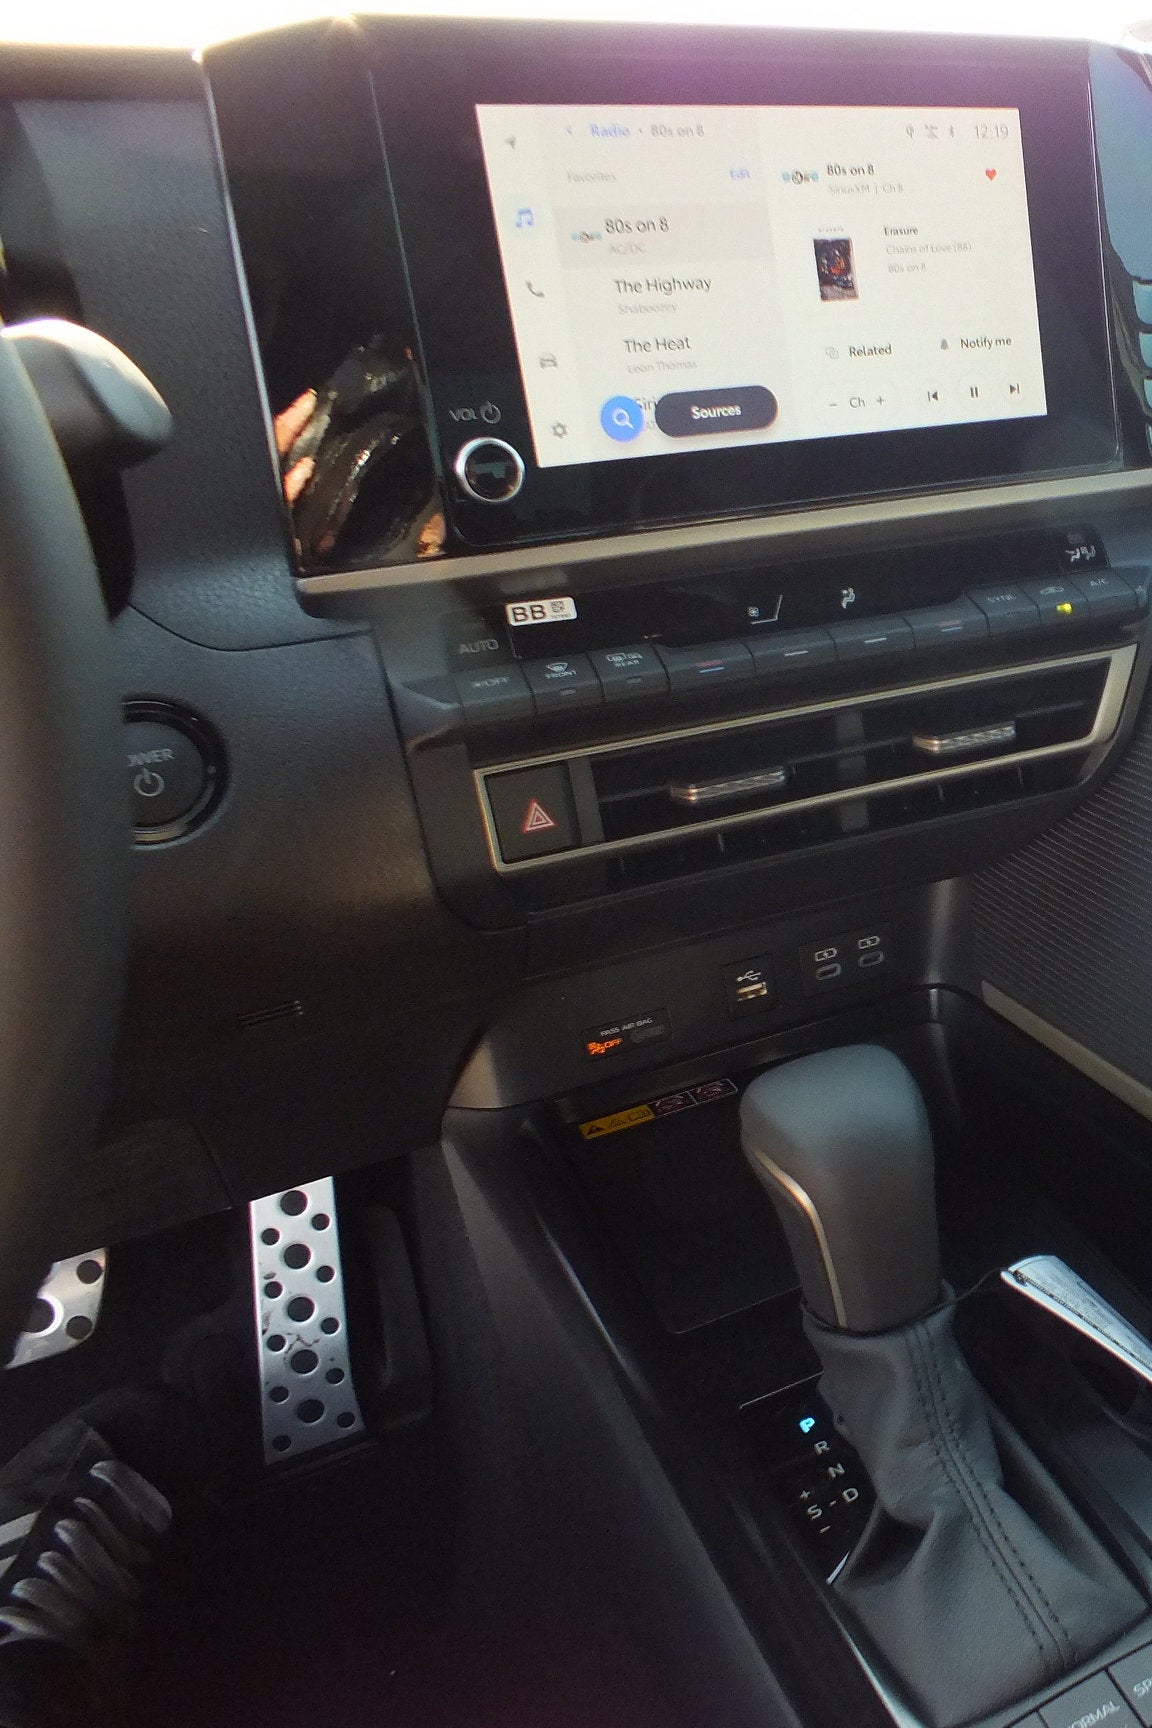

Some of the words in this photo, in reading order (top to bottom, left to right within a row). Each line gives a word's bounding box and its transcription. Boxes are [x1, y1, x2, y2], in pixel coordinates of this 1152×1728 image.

[590, 124, 631, 138] Radio
[650, 124, 674, 138] 80s
[677, 127, 695, 138] on
[696, 124, 705, 137] 8
[729, 167, 750, 180] Edit
[826, 165, 847, 177] 80s
[850, 167, 866, 177] on
[867, 164, 875, 176] 8
[605, 217, 633, 234] 80s
[636, 219, 656, 233] on
[660, 215, 670, 232] 8
[883, 225, 919, 237] Erasure
[888, 263, 905, 274] 80s
[907, 264, 920, 273] on
[614, 278, 643, 294] The
[646, 276, 713, 296] Highway
[623, 338, 652, 354] The
[655, 335, 692, 351] Heat
[848, 343, 893, 358] Related
[960, 337, 993, 350] Notify
[995, 337, 1012, 347] me
[849, 396, 866, 409] Ch
[691, 403, 742, 421] Sources
[512, 604, 547, 623] BB
[459, 638, 499, 655] AUTO
[799, 1417, 816, 1434] P
[813, 1440, 830, 1456] R
[827, 1462, 846, 1480] N
[842, 1487, 859, 1503] D
[807, 1504, 823, 1520] S
